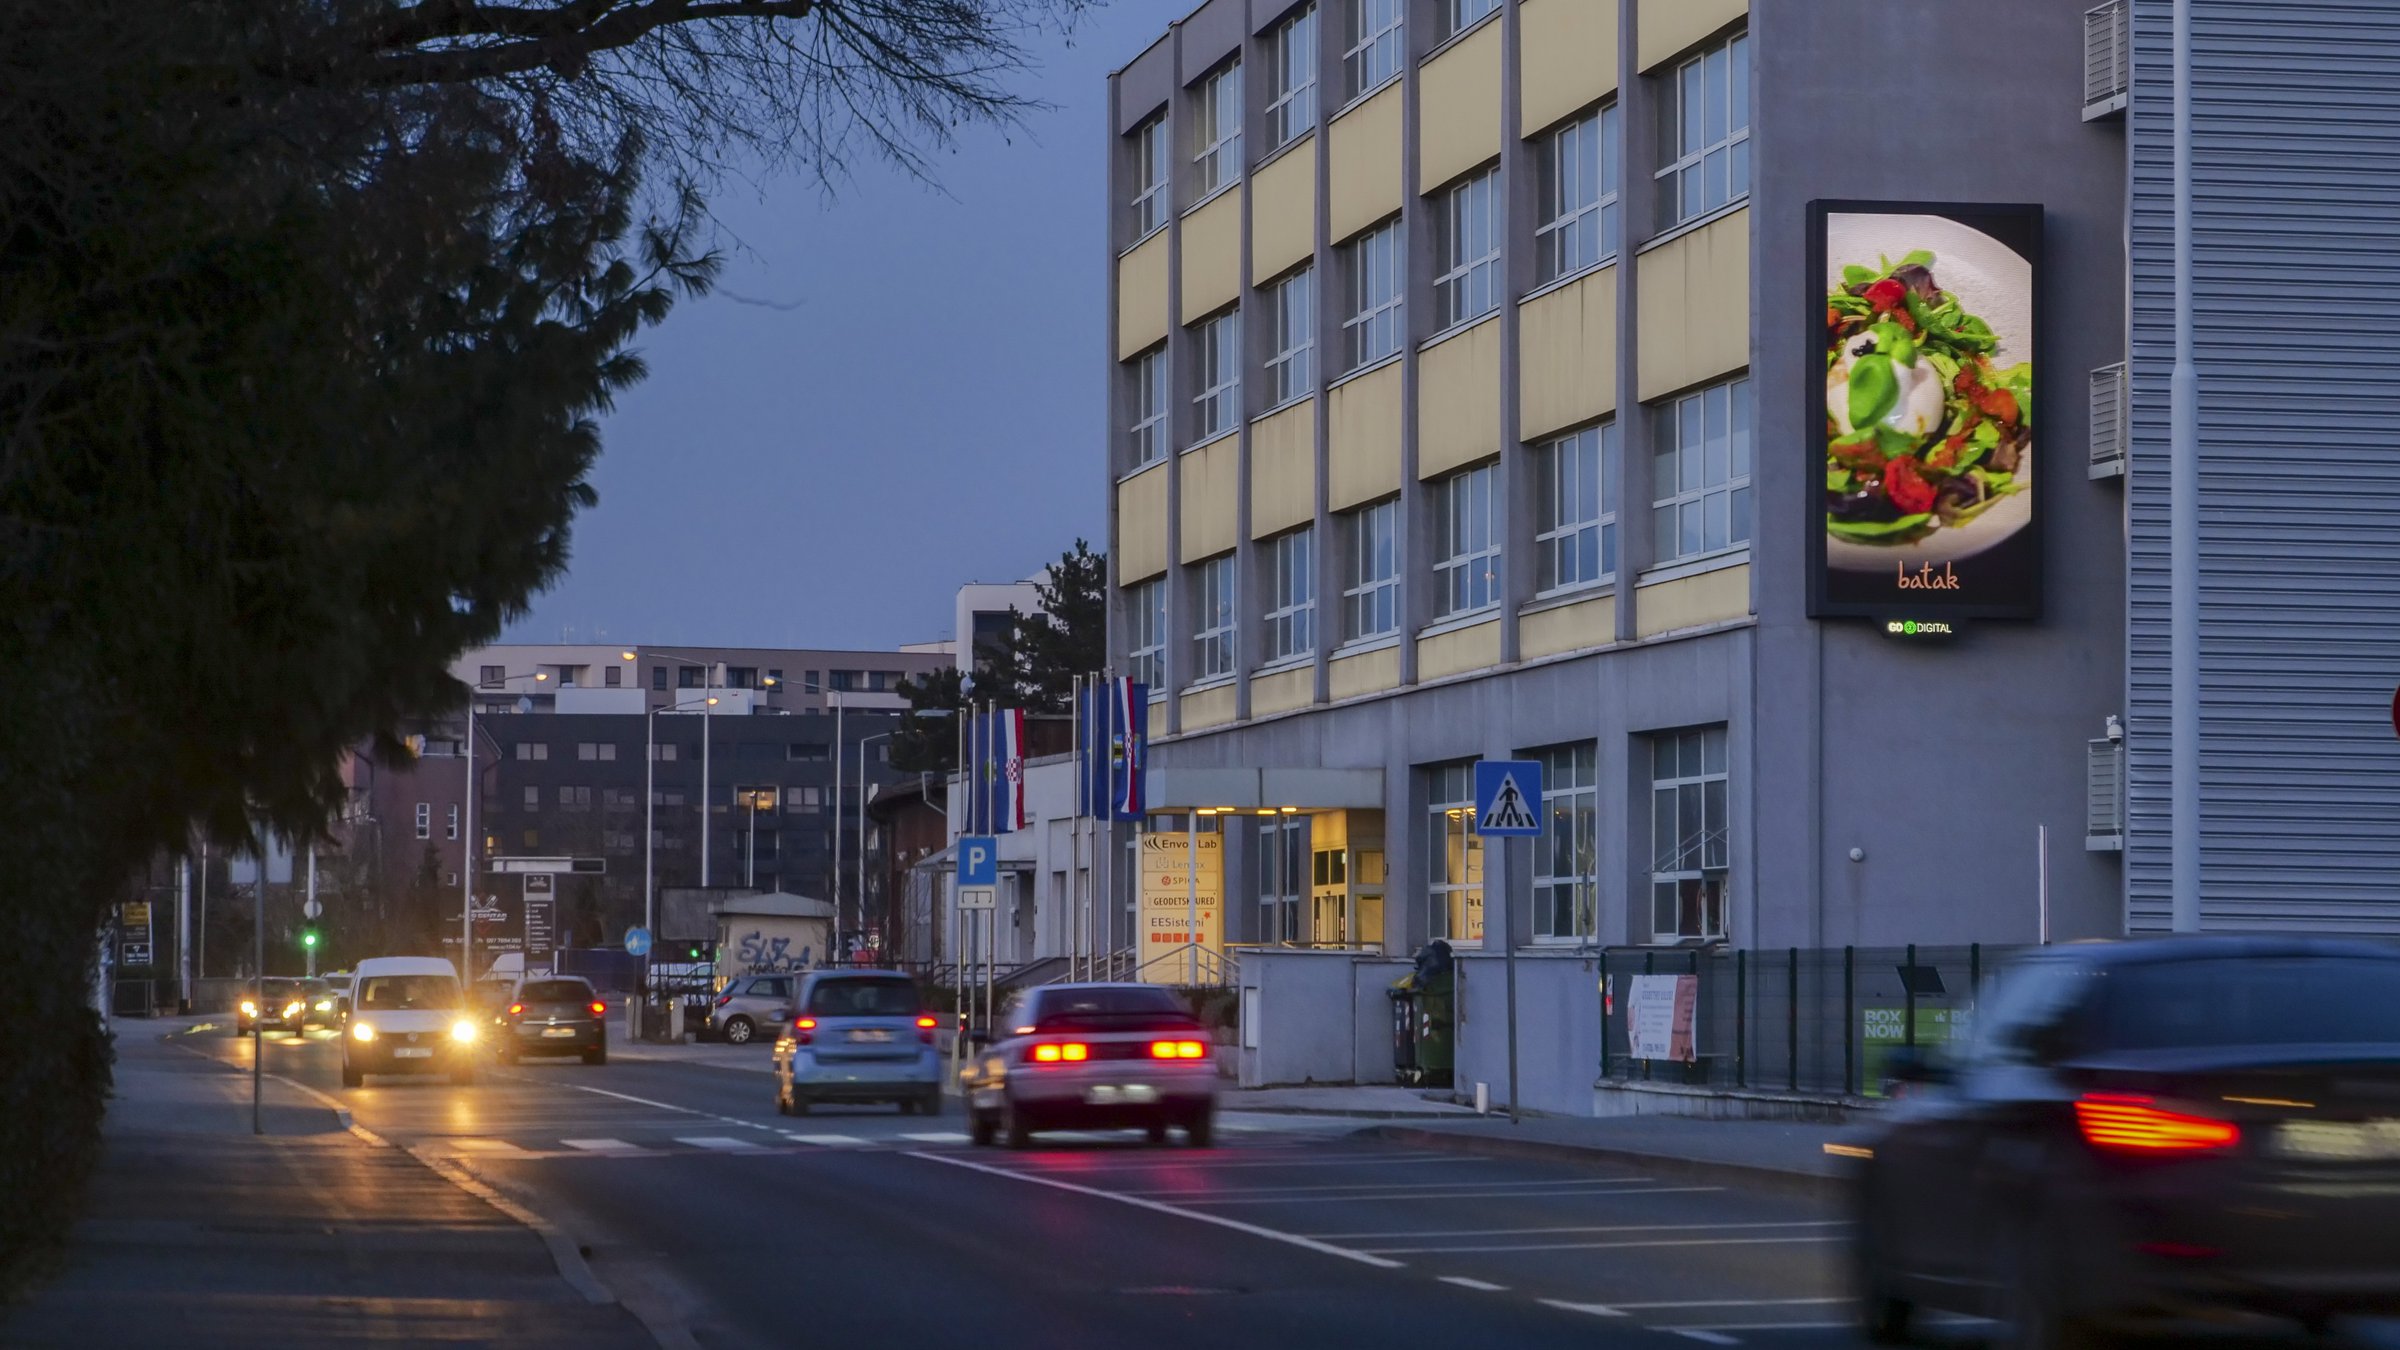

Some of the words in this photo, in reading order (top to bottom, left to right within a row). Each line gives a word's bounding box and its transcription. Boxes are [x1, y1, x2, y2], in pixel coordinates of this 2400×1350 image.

[1898, 560, 1960, 590] batak
[1888, 622, 1904, 633] GO
[1916, 623, 1952, 634] DIGITAL
[1162, 839, 1190, 849] Envo
[1198, 839, 1217, 849] Lab
[969, 847, 986, 876] P
[1153, 896, 1190, 906] GEODETSK
[1194, 896, 1215, 905] URED
[1864, 1010, 1901, 1024] BOX
[1864, 1024, 1905, 1038] NOW
